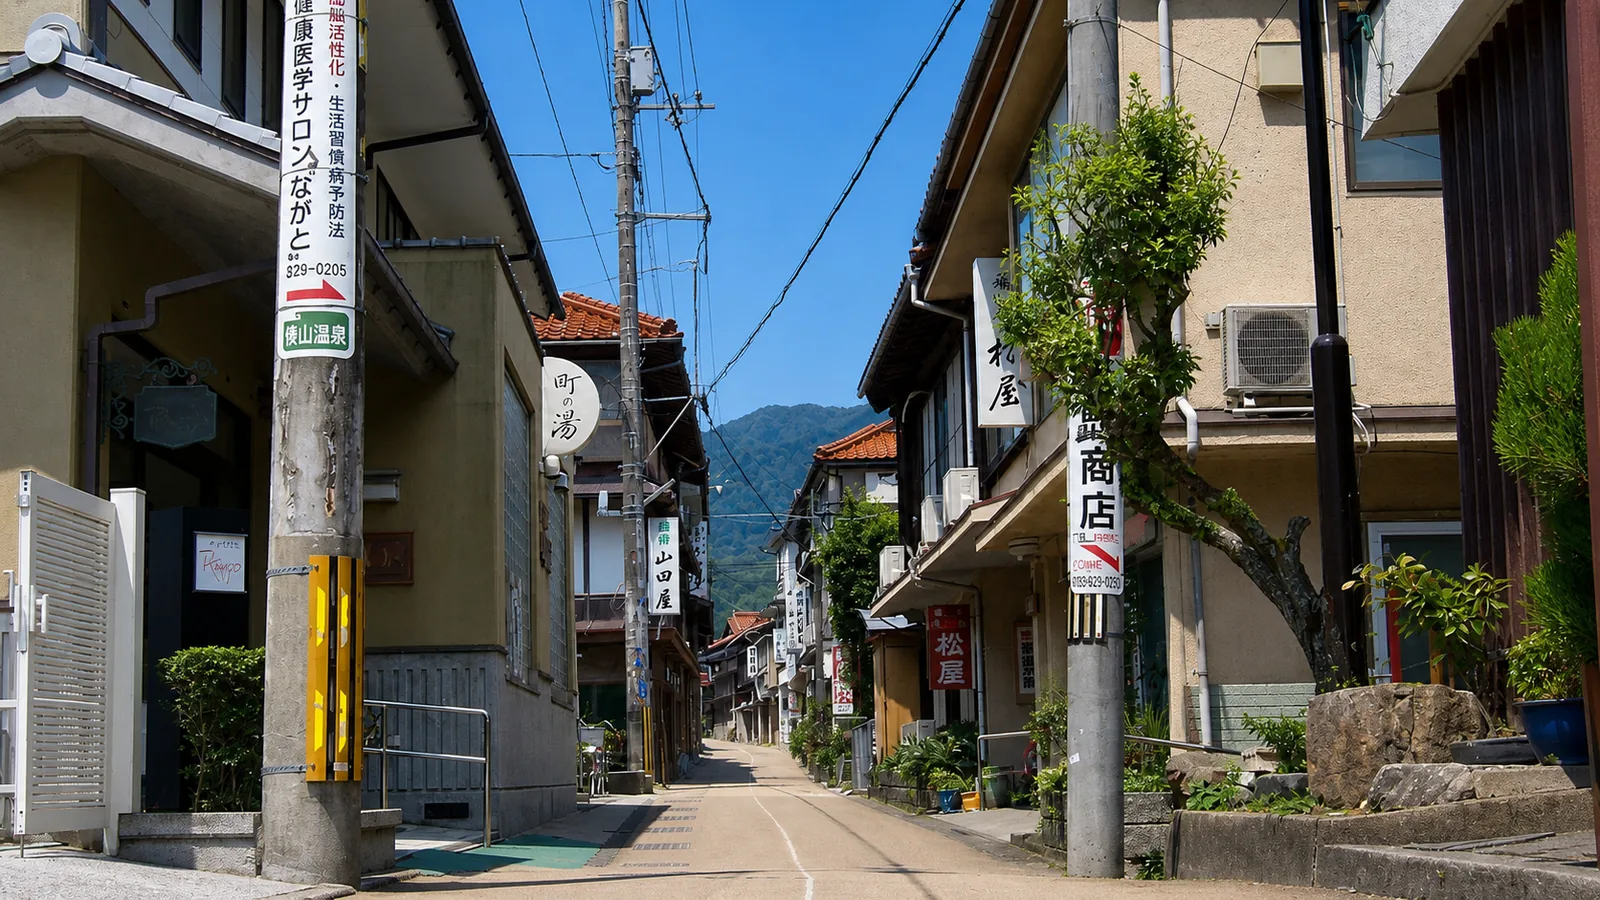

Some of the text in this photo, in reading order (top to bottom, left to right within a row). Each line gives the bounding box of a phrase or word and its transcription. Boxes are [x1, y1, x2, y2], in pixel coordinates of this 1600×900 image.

[286, 262, 347, 278] 829-0205
[551, 373, 582, 440] 町の湯
[654, 550, 674, 610] 山田屋
[934, 632, 966, 685] 松屋
